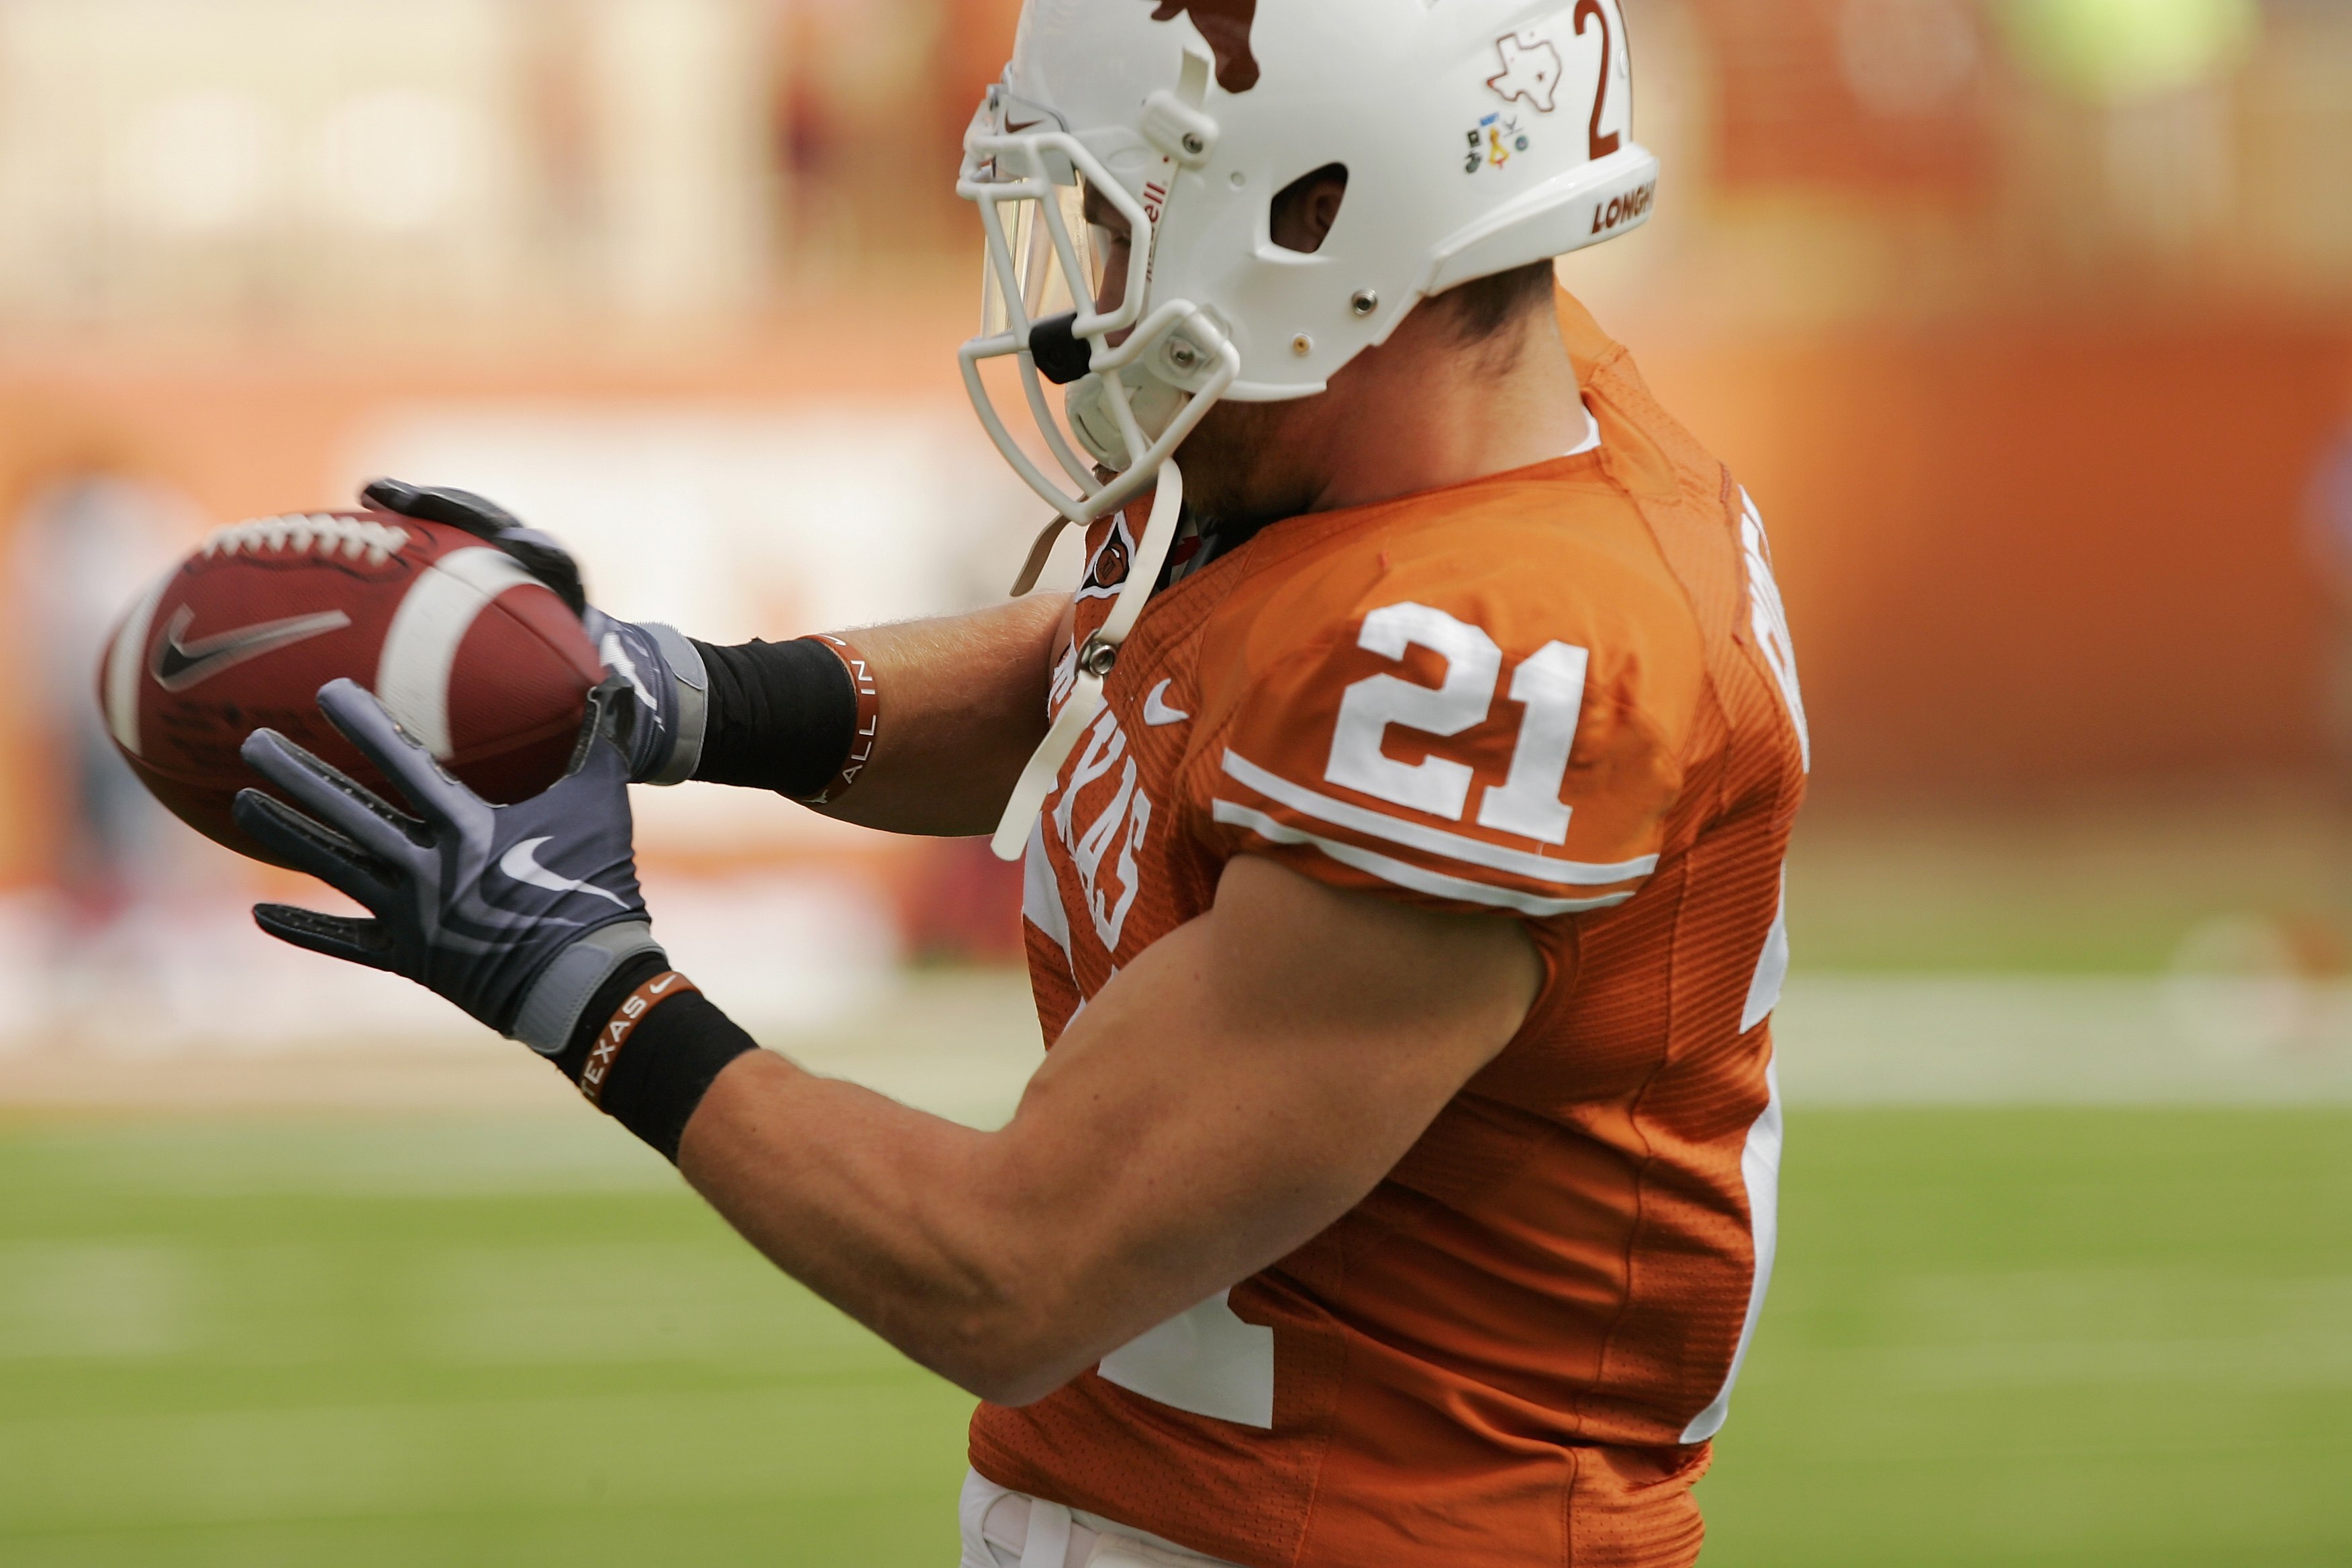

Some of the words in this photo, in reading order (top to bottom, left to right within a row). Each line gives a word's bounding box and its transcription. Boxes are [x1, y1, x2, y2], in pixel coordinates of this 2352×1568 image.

[850, 660, 875, 695] IN
[842, 714, 877, 784] ALL
[1324, 601, 1589, 845] 21
[581, 995, 648, 1097] TEXAS
